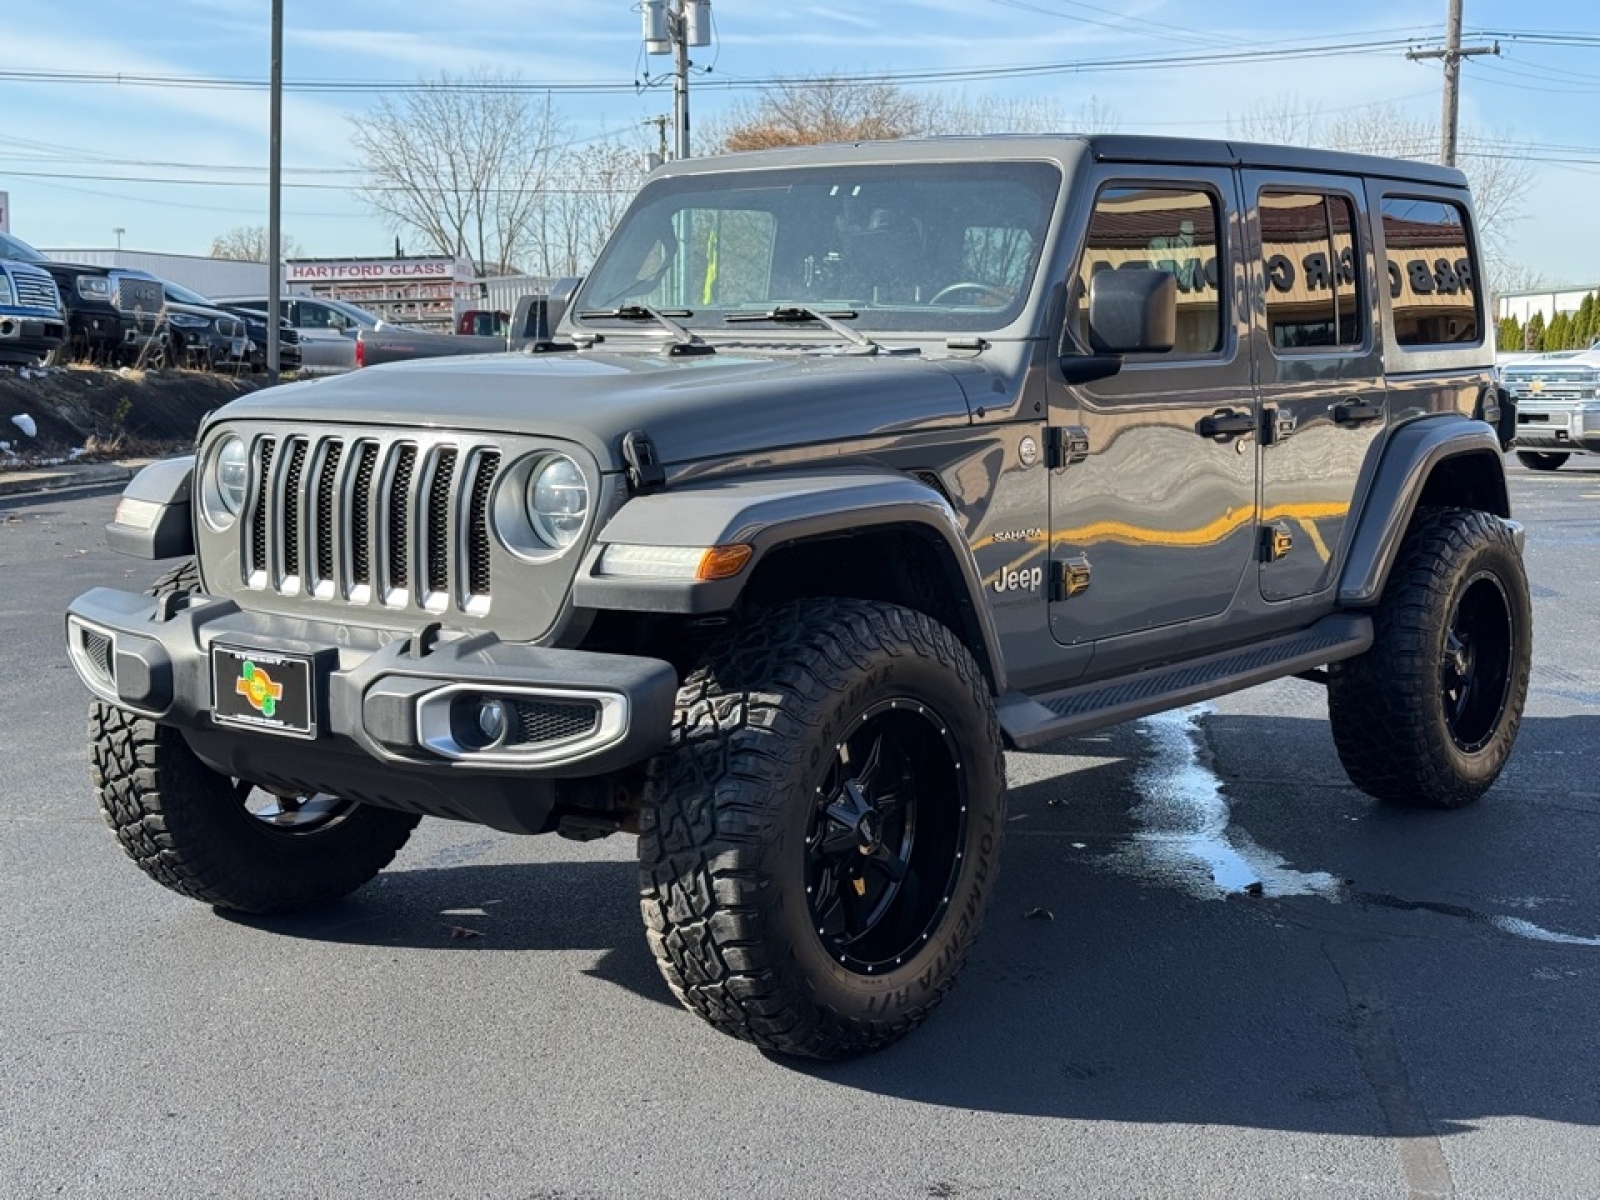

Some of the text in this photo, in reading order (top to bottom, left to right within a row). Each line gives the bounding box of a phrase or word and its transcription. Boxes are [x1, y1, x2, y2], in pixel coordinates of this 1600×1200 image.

[293, 264, 385, 278] HARTFORD
[389, 263, 446, 276] GLASS
[992, 527, 1041, 542] SAHARA
[993, 566, 1042, 592] Jeep
[915, 808, 996, 992] TORMENTA
